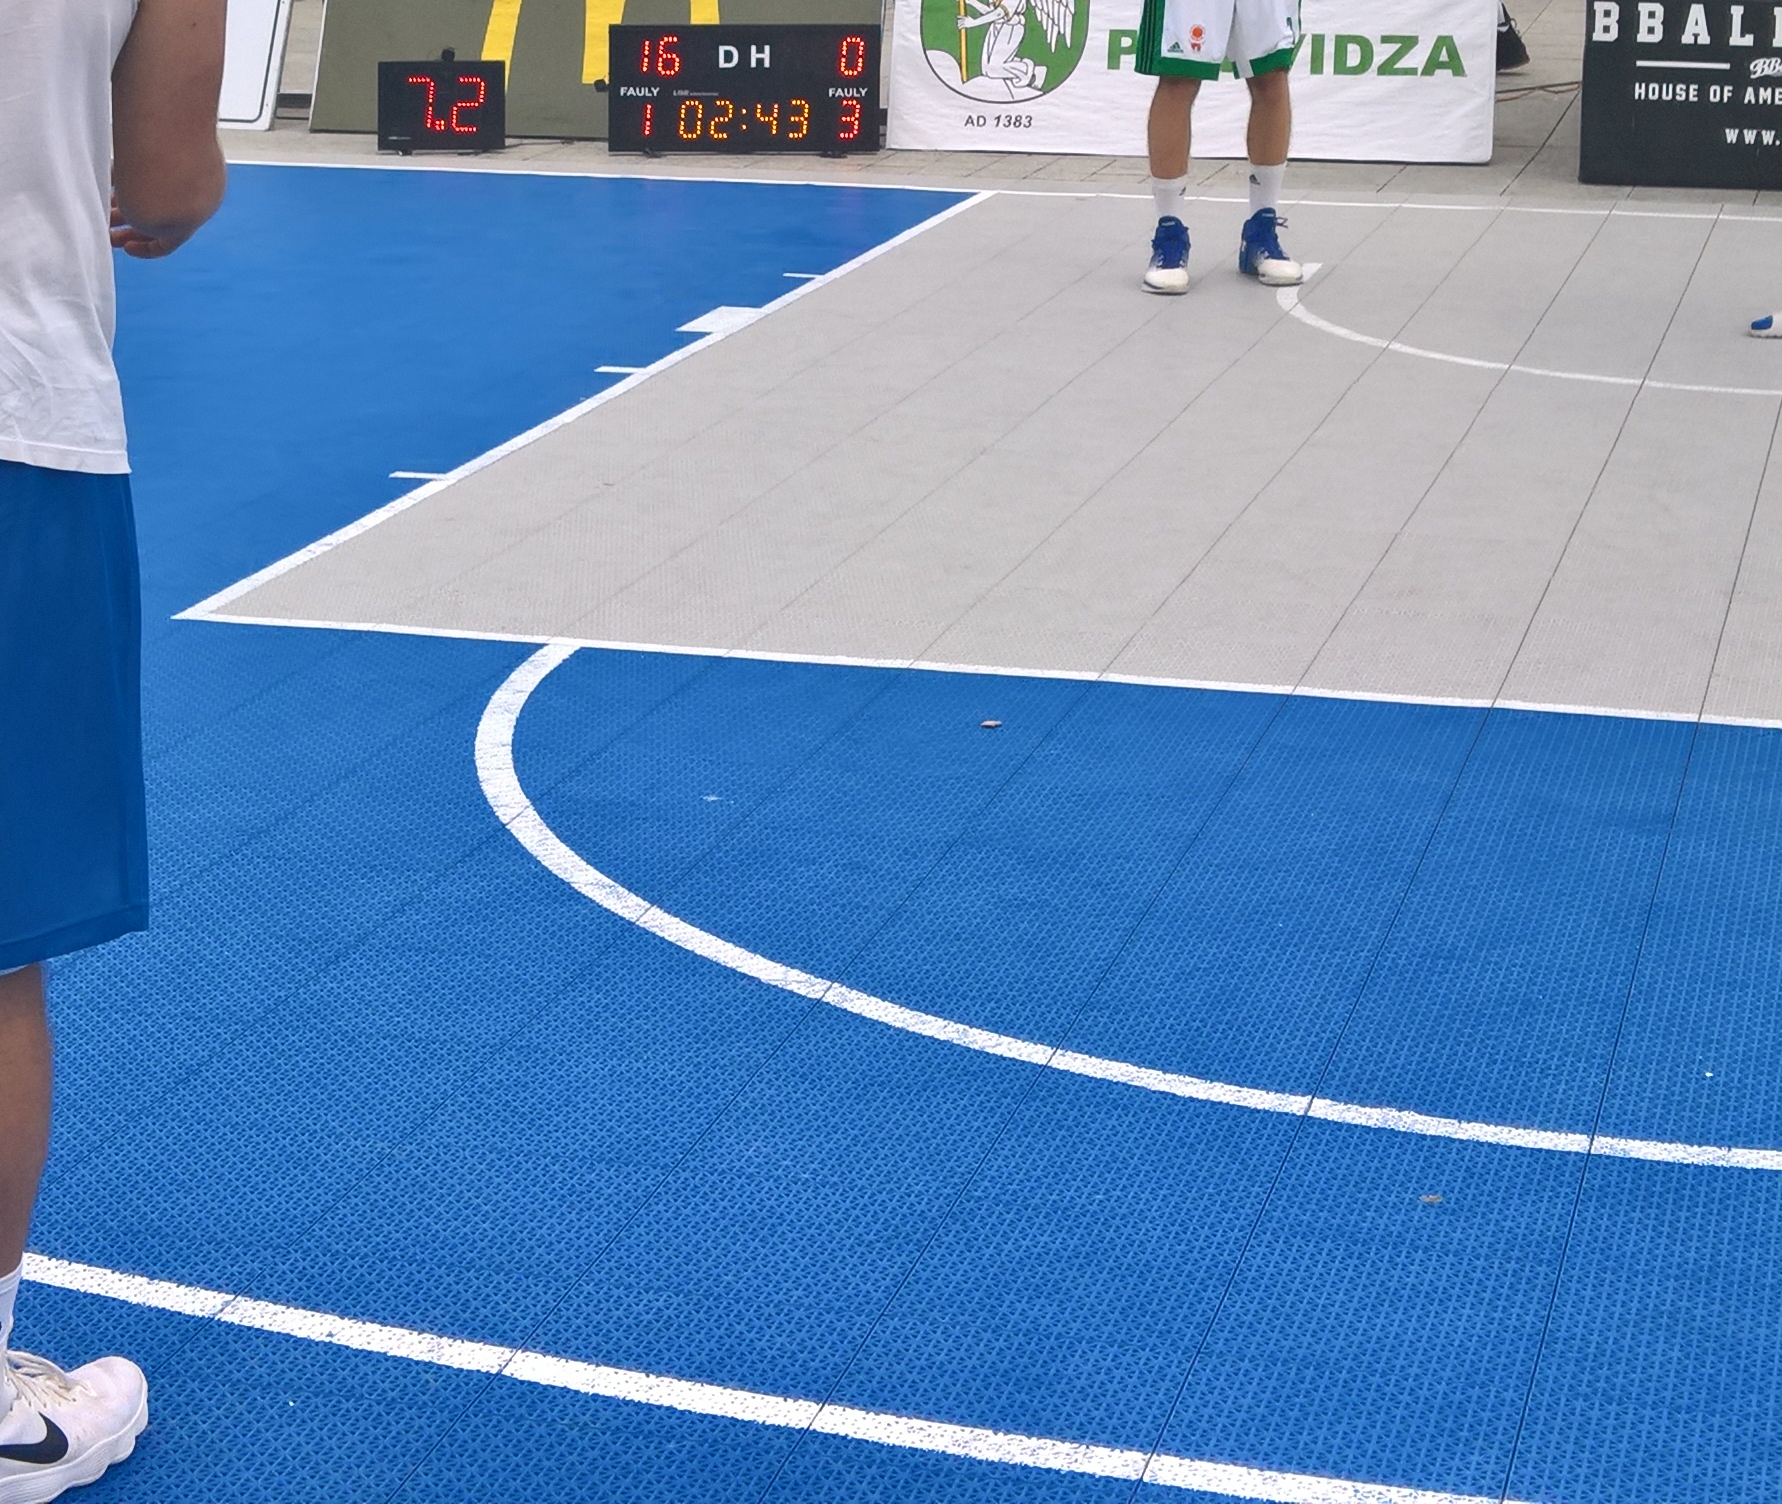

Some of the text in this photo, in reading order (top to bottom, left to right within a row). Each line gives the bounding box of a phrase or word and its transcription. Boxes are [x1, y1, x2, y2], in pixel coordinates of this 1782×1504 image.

[641, 35, 865, 78] 16 D H 0
[620, 86, 660, 97] FAULY
[828, 87, 868, 98] FAULY
[1634, 82, 1699, 102] HOUSE
[1709, 83, 1733, 103] OF
[678, 99, 810, 140] 02:43
[839, 99, 862, 140] 3
[964, 113, 1033, 129] AD 1383
